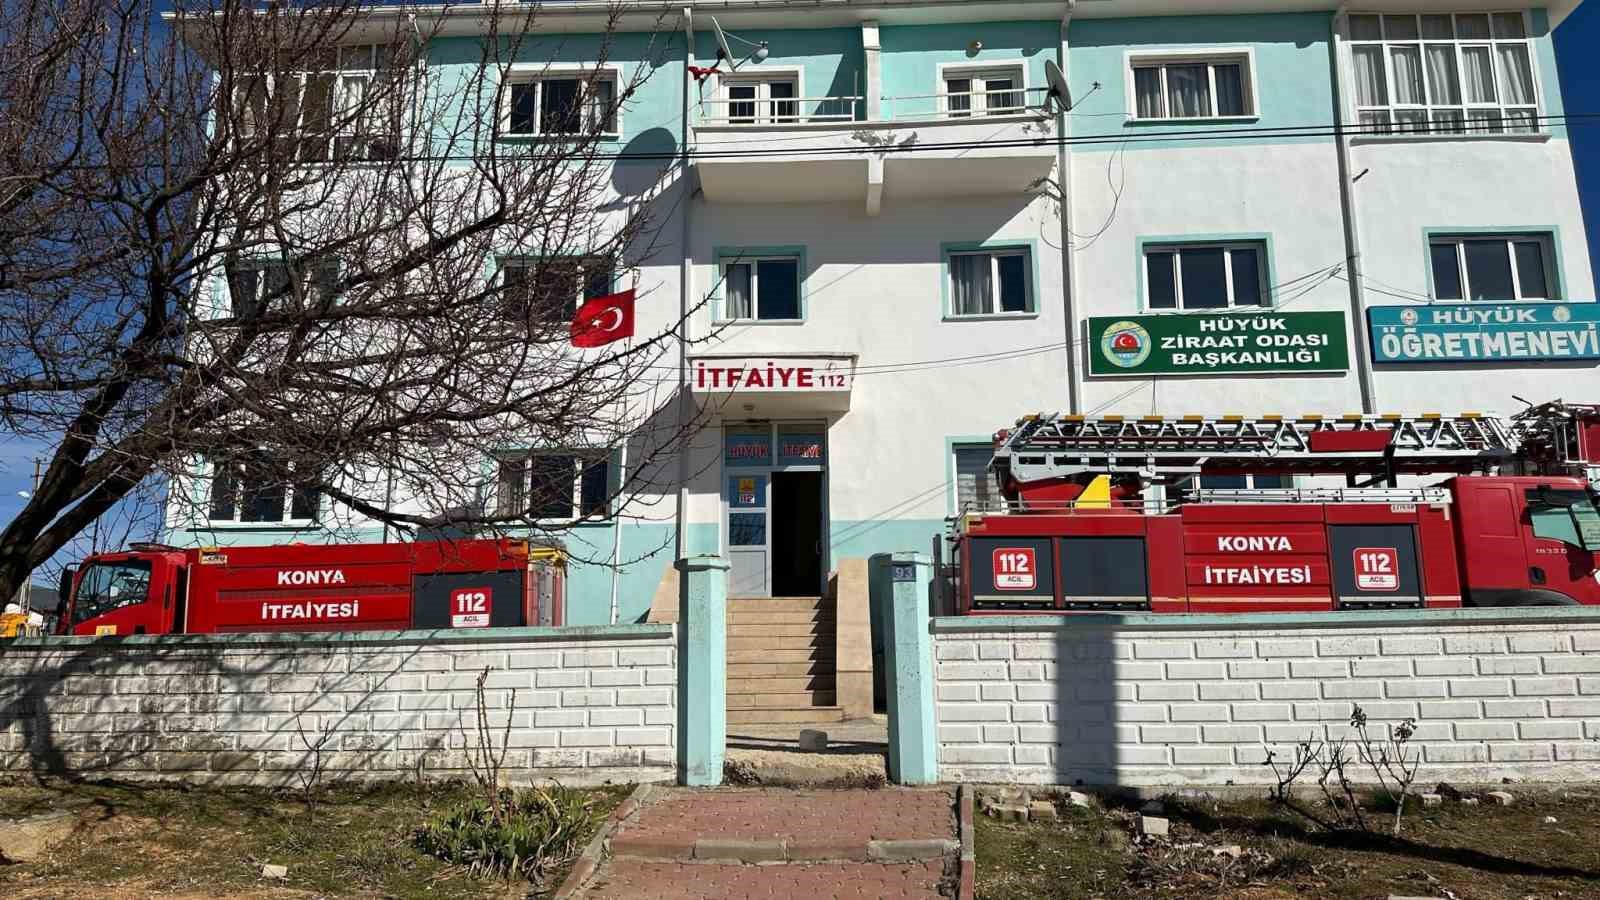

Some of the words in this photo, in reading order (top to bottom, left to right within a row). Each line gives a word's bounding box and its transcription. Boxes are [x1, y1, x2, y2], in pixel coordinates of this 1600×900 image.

[1200, 316, 1287, 331] HÜYÜK
[1432, 306, 1537, 324] HÜYÜK
[1160, 334, 1249, 349] ZİRAAT
[1255, 334, 1329, 347] ODASI
[1381, 322, 1600, 358] ÖĞRETMENEVİ
[1172, 348, 1321, 367] BAŞKANLIĞI
[698, 362, 814, 388] İTFAİYE
[818, 374, 845, 387] 112
[1217, 536, 1293, 551] KONYA
[895, 567, 913, 577] 93
[999, 553, 1029, 572] 112
[1360, 552, 1392, 573] 112
[277, 569, 346, 585] KONYA
[1204, 563, 1312, 584] İTFAİYESİ
[261, 599, 359, 620] İTFAİYESİ
[456, 592, 486, 612] 112
